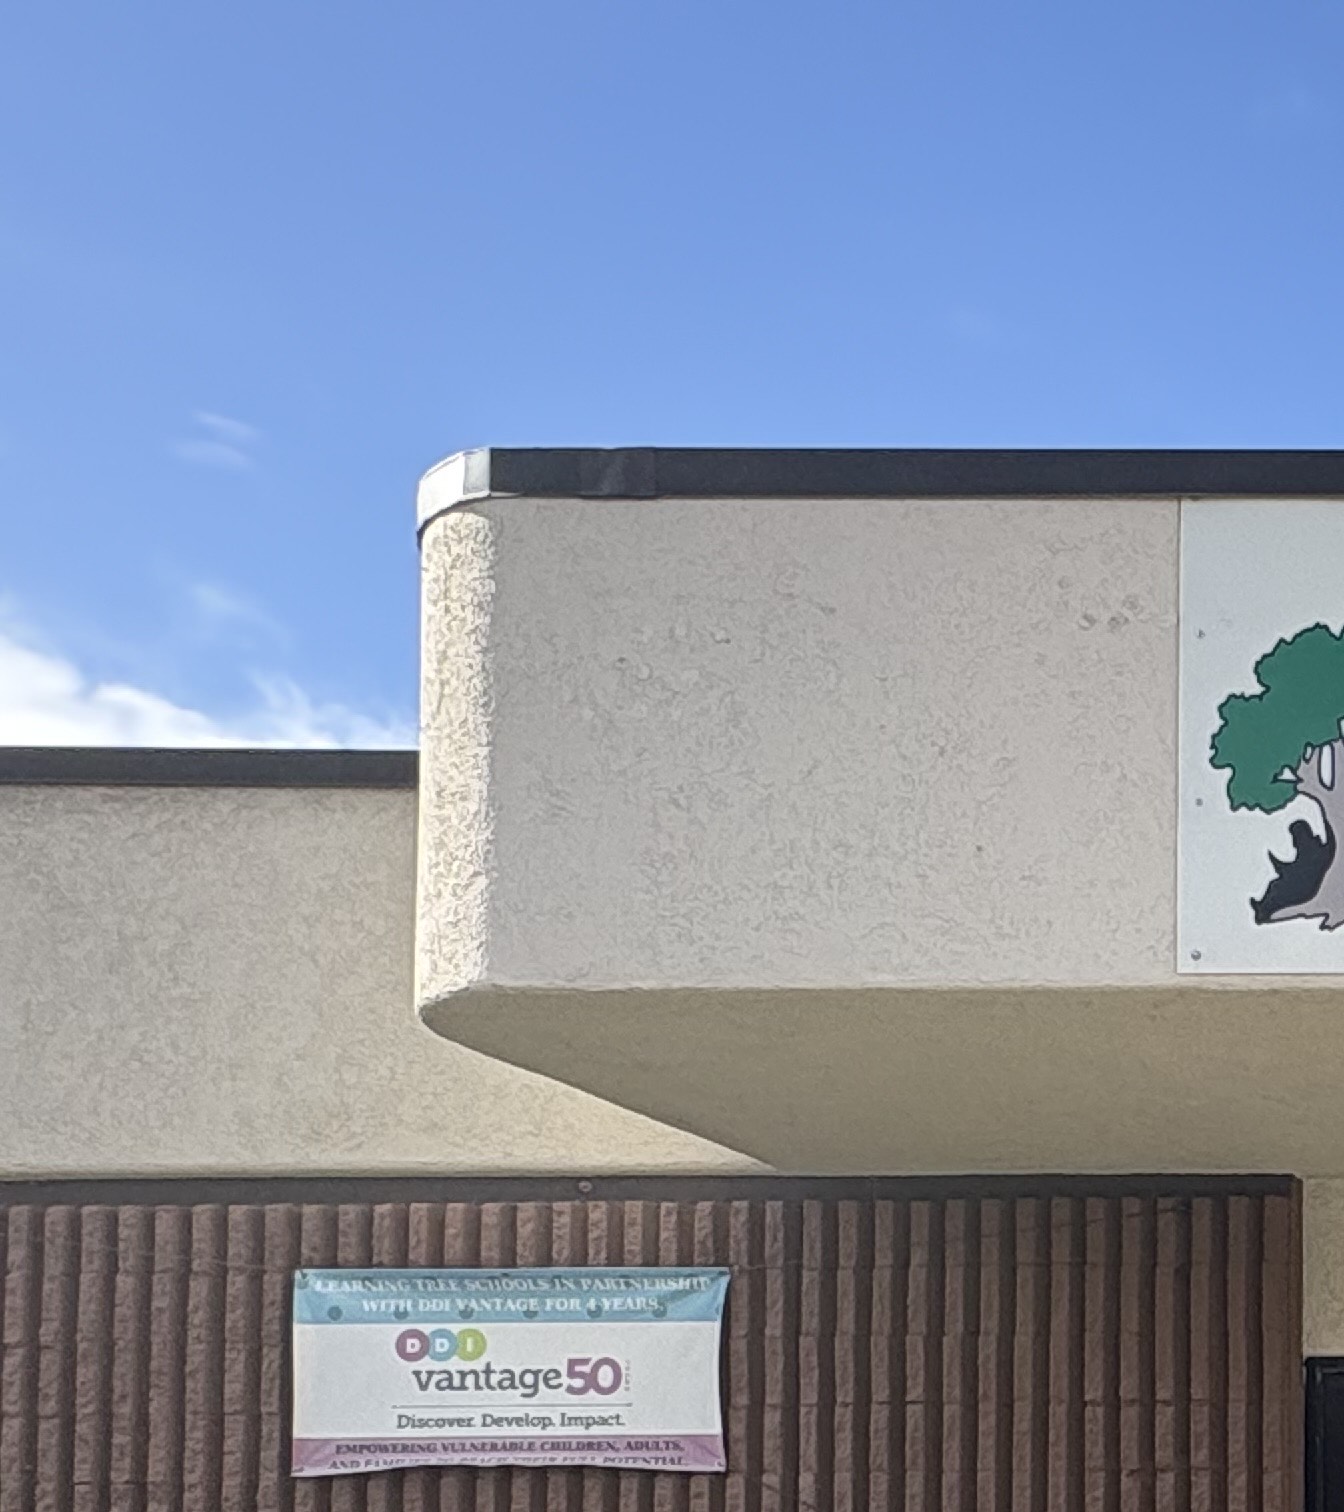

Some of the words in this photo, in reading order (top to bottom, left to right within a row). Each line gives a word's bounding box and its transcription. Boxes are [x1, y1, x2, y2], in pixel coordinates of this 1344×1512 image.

[314, 1278, 411, 1292] LEARNING
[416, 1278, 462, 1292] TREE
[466, 1277, 550, 1291] SCHOOLS
[553, 1277, 577, 1291] IN
[362, 1298, 414, 1312] WITH
[418, 1298, 451, 1312] DDI
[455, 1298, 540, 1312] VANTAGE
[544, 1298, 582, 1312] FOR
